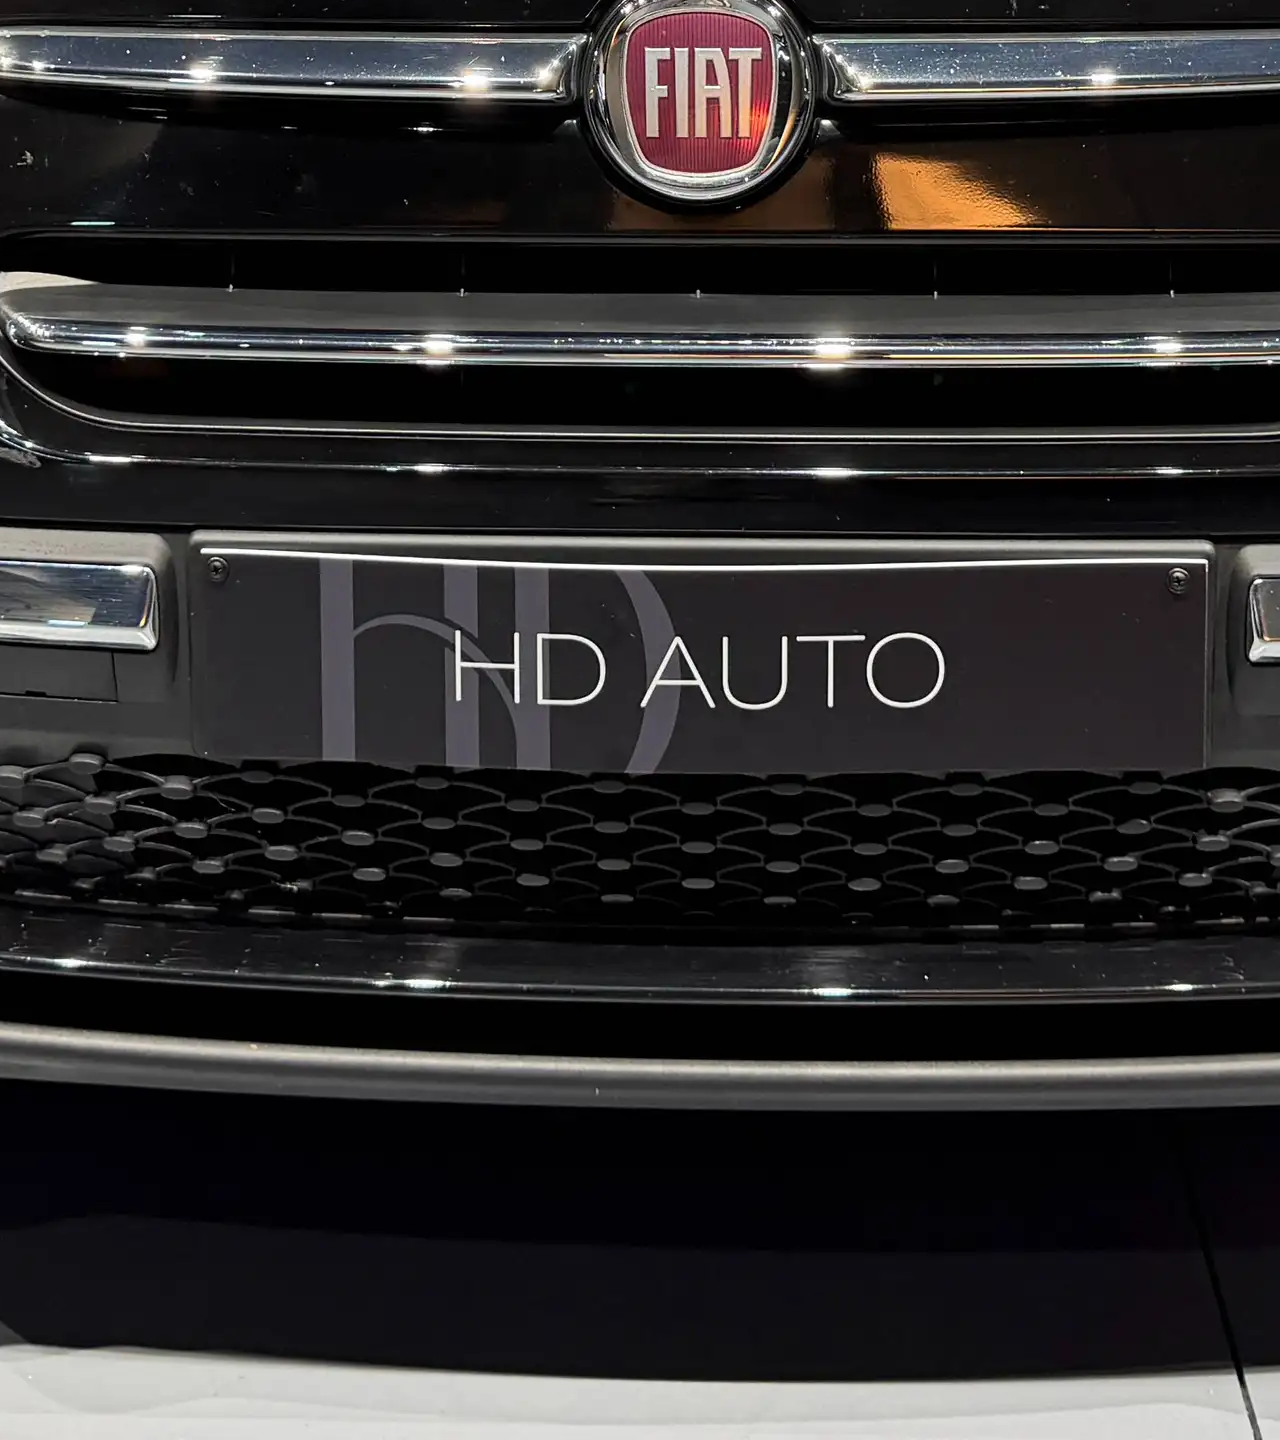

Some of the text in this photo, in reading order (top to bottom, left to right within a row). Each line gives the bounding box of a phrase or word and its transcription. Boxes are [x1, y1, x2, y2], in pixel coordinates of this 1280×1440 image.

[644, 47, 762, 138] FIAT
[453, 630, 946, 710] HD AUTO
